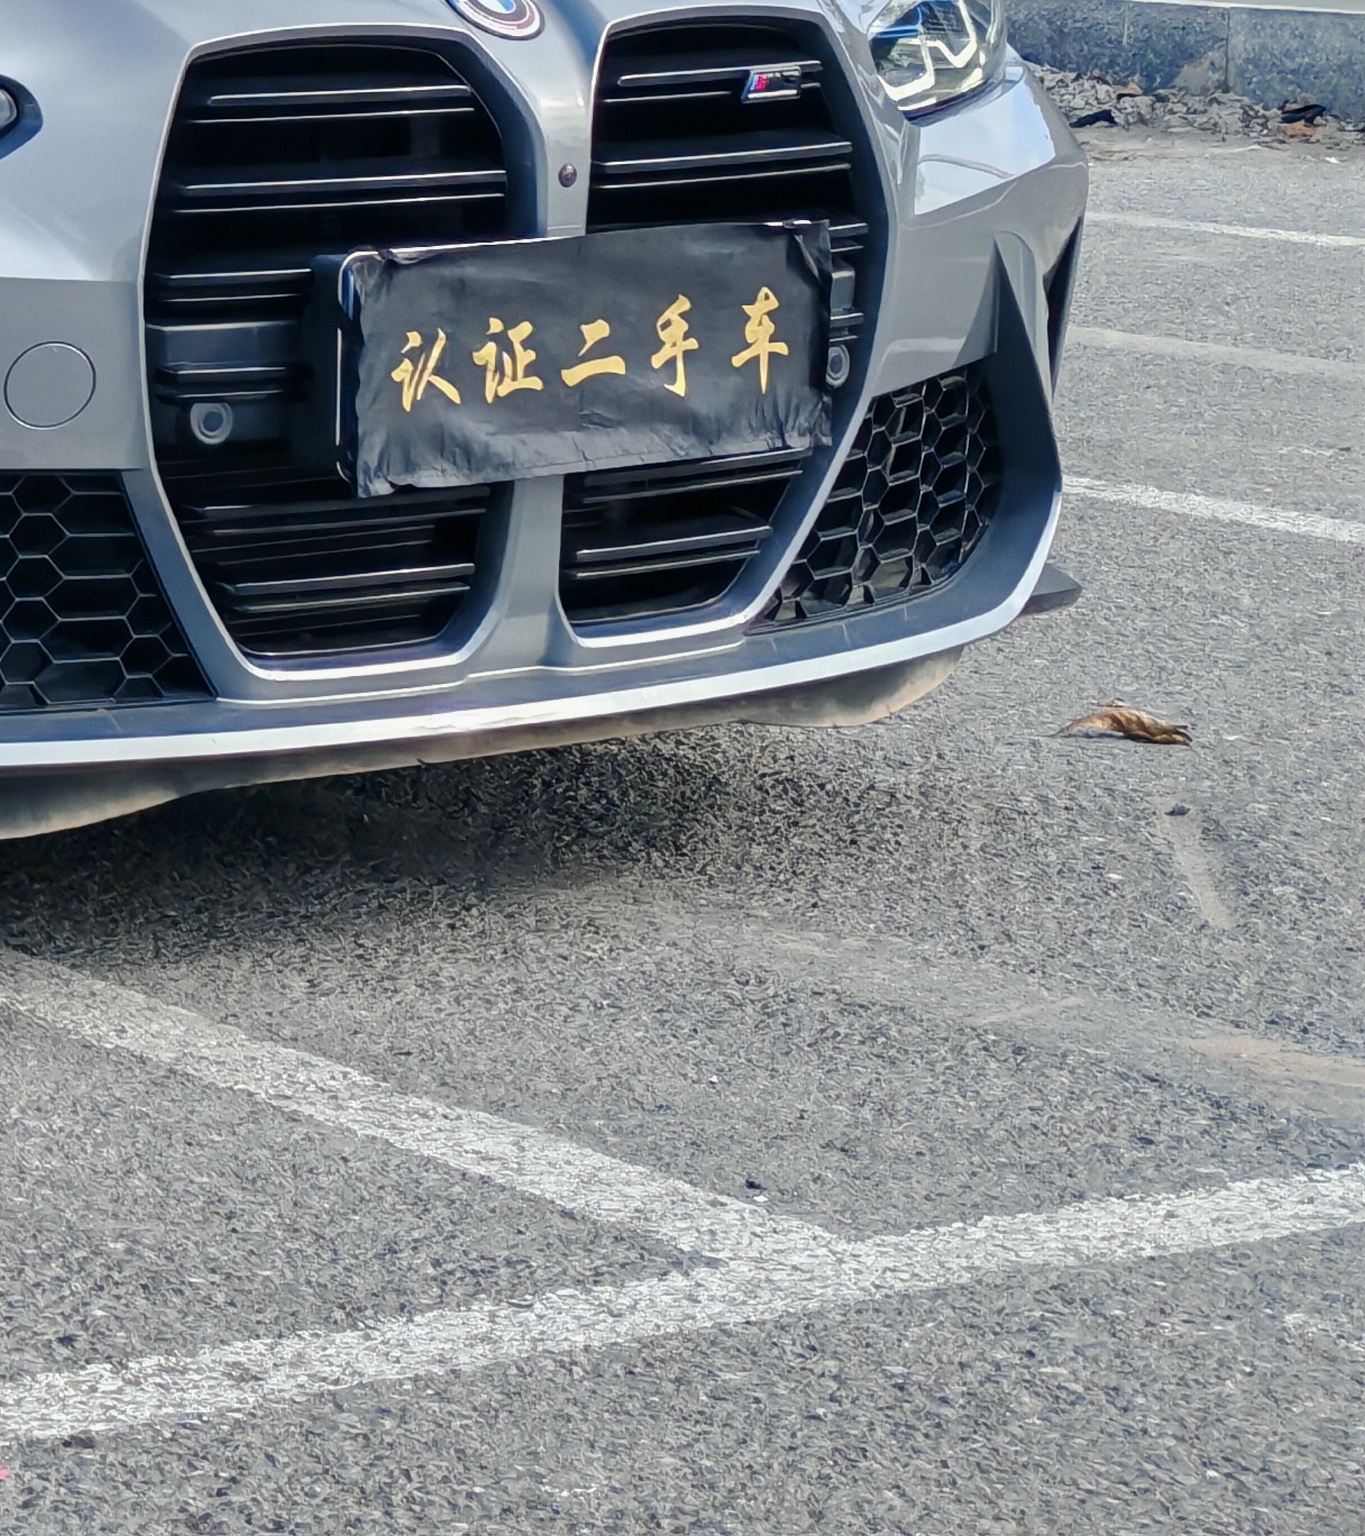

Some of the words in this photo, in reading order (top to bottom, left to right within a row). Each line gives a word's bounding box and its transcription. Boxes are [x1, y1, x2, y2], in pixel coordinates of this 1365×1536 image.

[391, 286, 789, 412] 认证二手车
